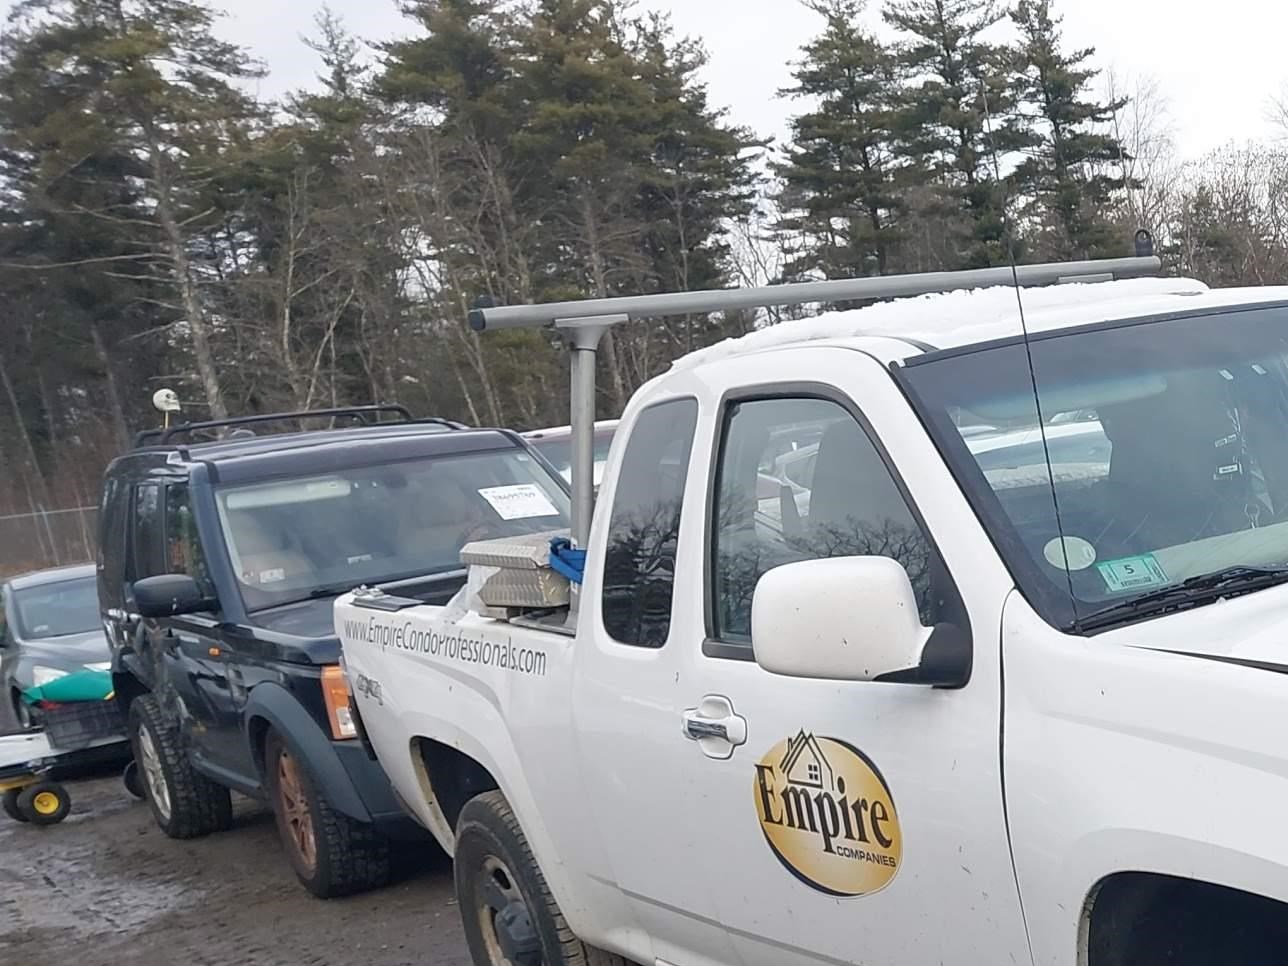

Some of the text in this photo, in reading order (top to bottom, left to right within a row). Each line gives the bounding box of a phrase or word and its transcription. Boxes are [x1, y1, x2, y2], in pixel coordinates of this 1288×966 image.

[1124, 565, 1134, 574] 5
[344, 617, 546, 676] www.EmpireCondoProfessionals.com
[754, 763, 893, 855] Empire
[836, 845, 897, 868] COMPANIES
